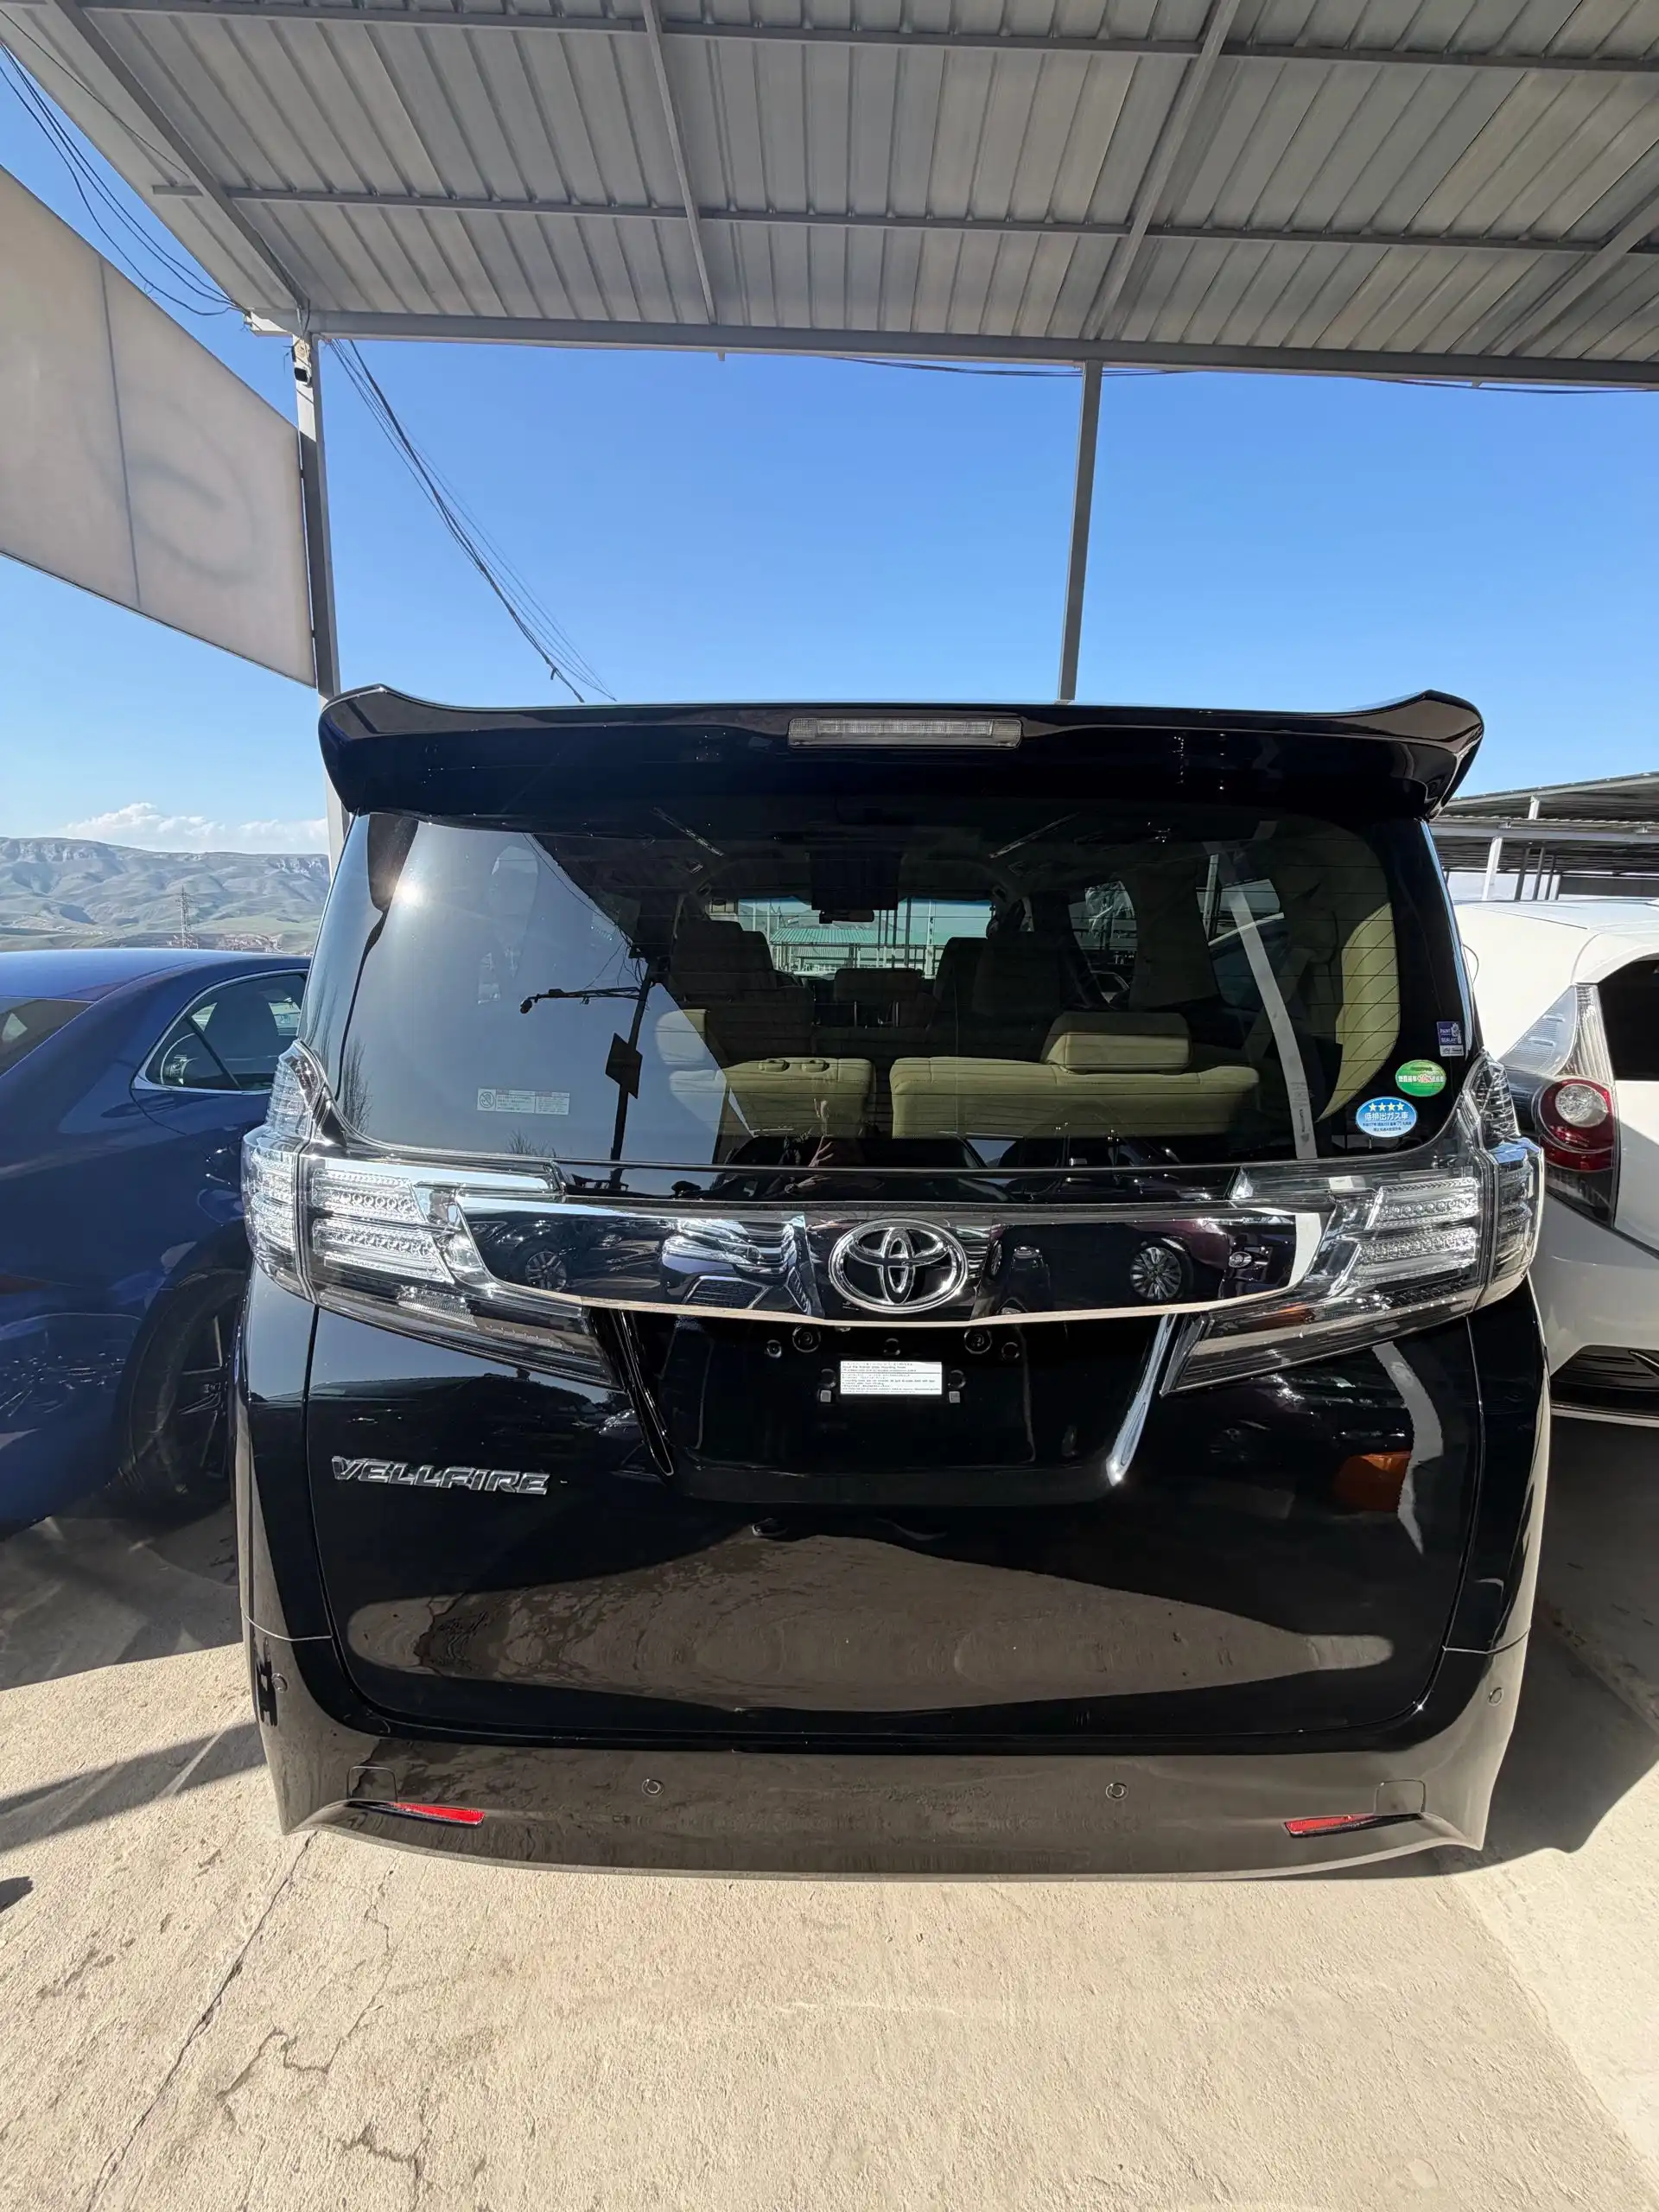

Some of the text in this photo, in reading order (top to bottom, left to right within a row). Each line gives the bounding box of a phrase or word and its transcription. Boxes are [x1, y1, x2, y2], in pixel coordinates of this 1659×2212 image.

[1364, 1111, 1409, 1122] 低排出ガス車
[331, 1456, 550, 1495] VELLFIRE
